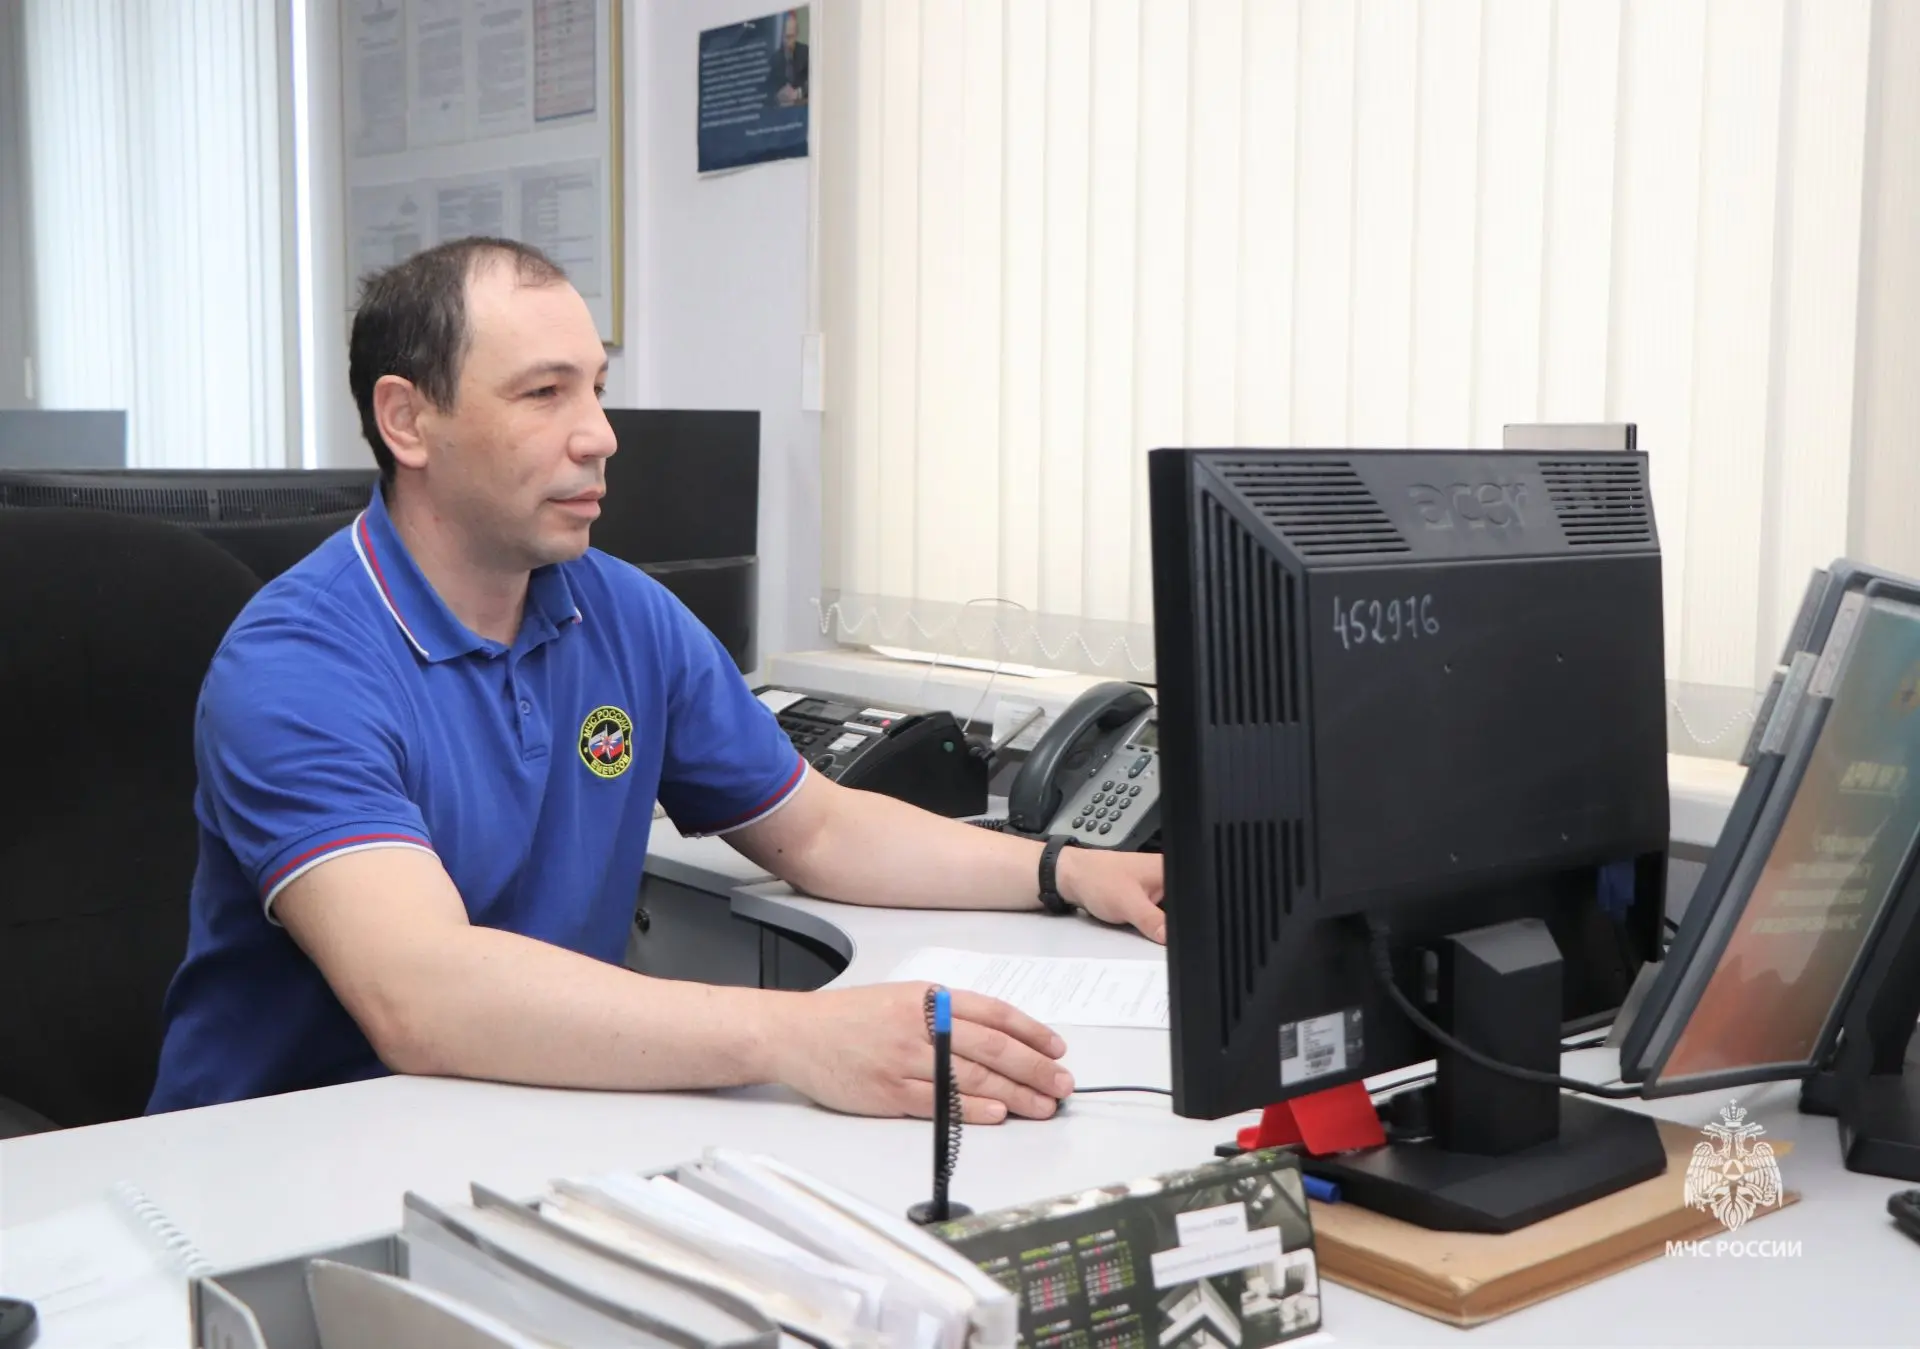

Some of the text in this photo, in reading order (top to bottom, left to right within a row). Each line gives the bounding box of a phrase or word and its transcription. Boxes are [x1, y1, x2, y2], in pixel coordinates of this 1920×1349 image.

[583, 709, 630, 738] МЧС РОССИИ
[591, 754, 630, 775] EMERCOM
